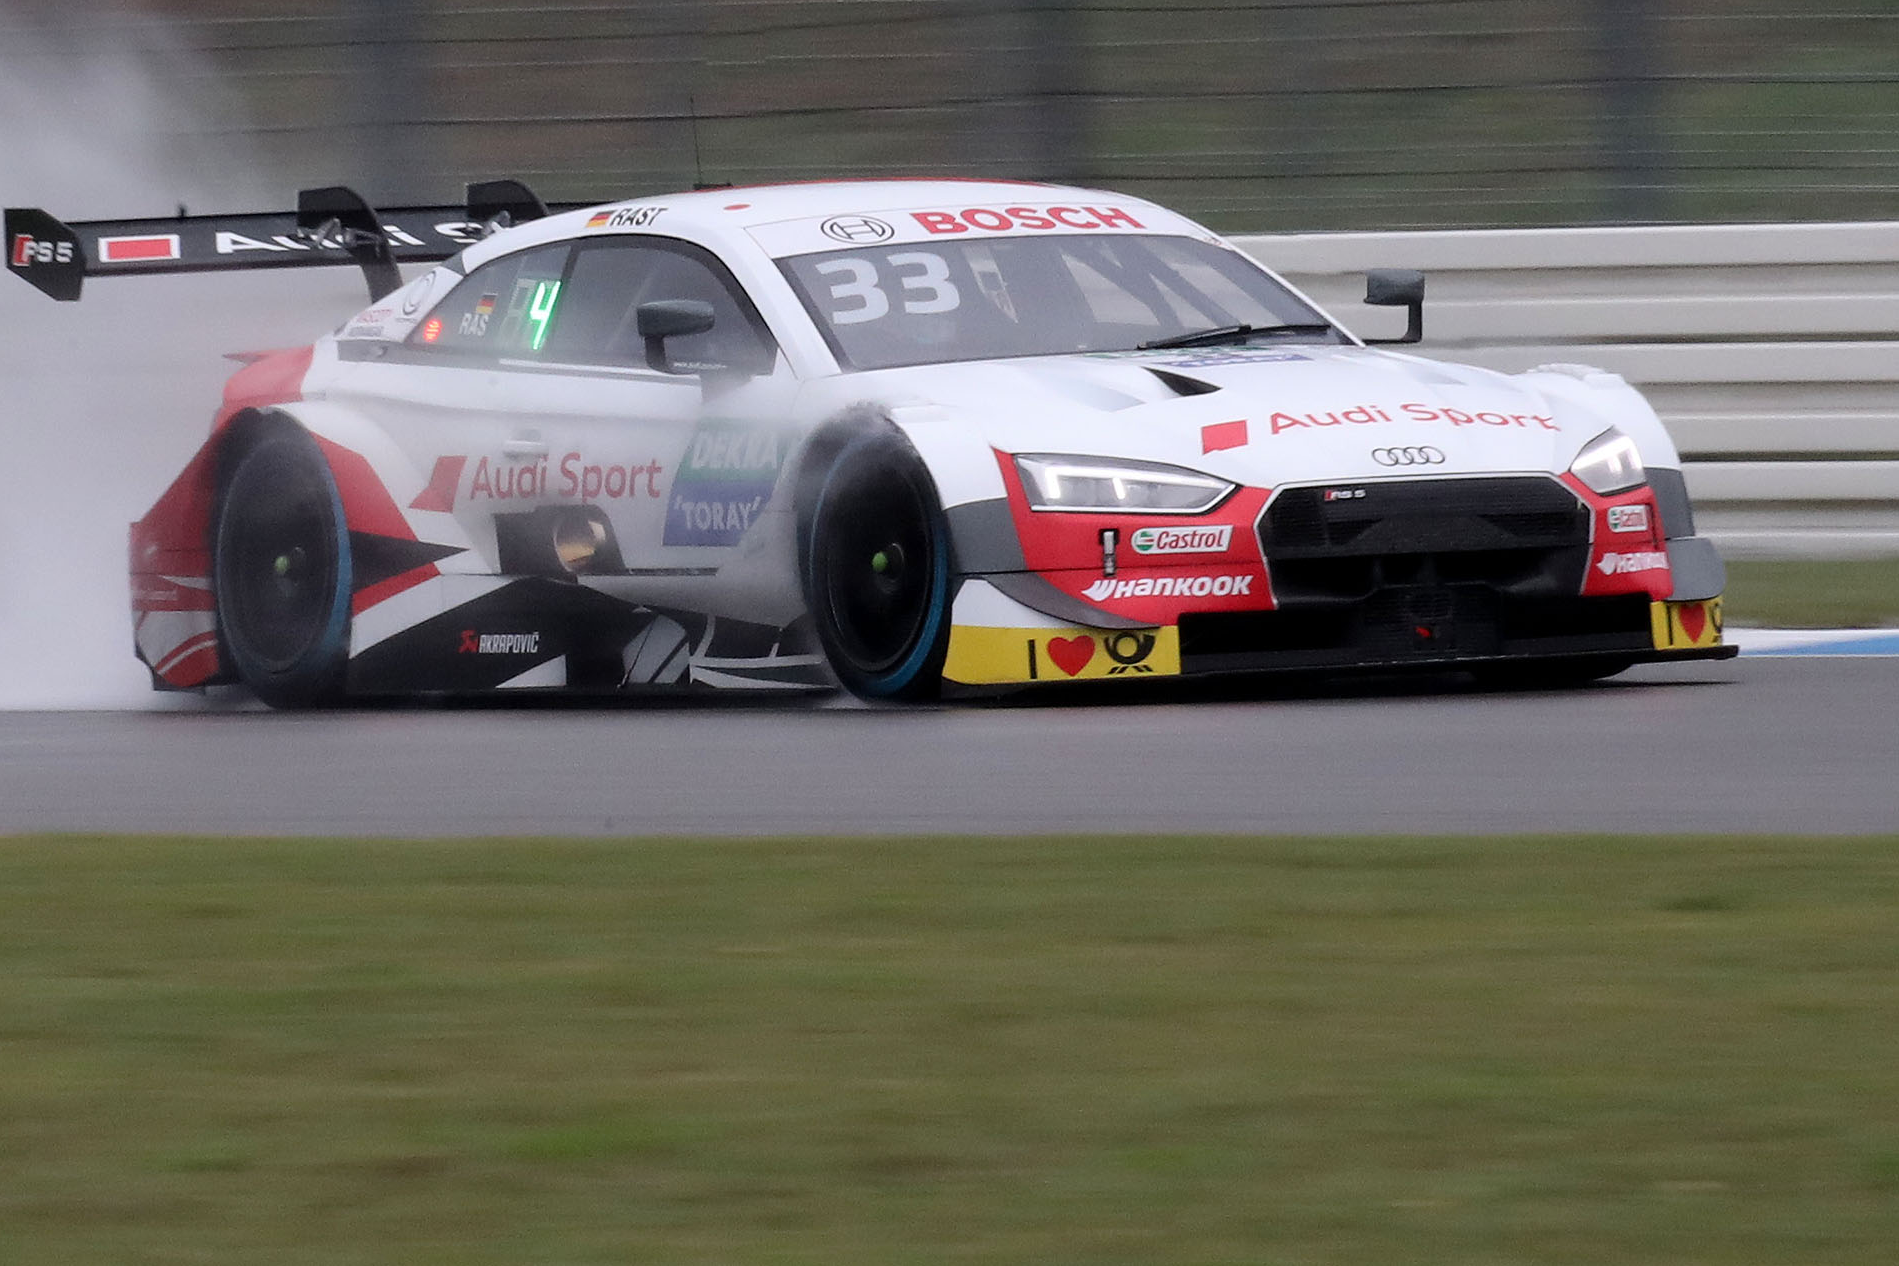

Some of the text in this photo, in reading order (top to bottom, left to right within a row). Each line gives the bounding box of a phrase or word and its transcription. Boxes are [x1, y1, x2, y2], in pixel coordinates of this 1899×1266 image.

[609, 208, 668, 227] RAST
[910, 207, 1147, 234] BOSCH
[815, 252, 961, 325] 33
[529, 280, 562, 351] 4
[1270, 403, 1561, 435] Audi Sport
[470, 451, 662, 504] Audi Sport
[1156, 530, 1224, 550] Castrol
